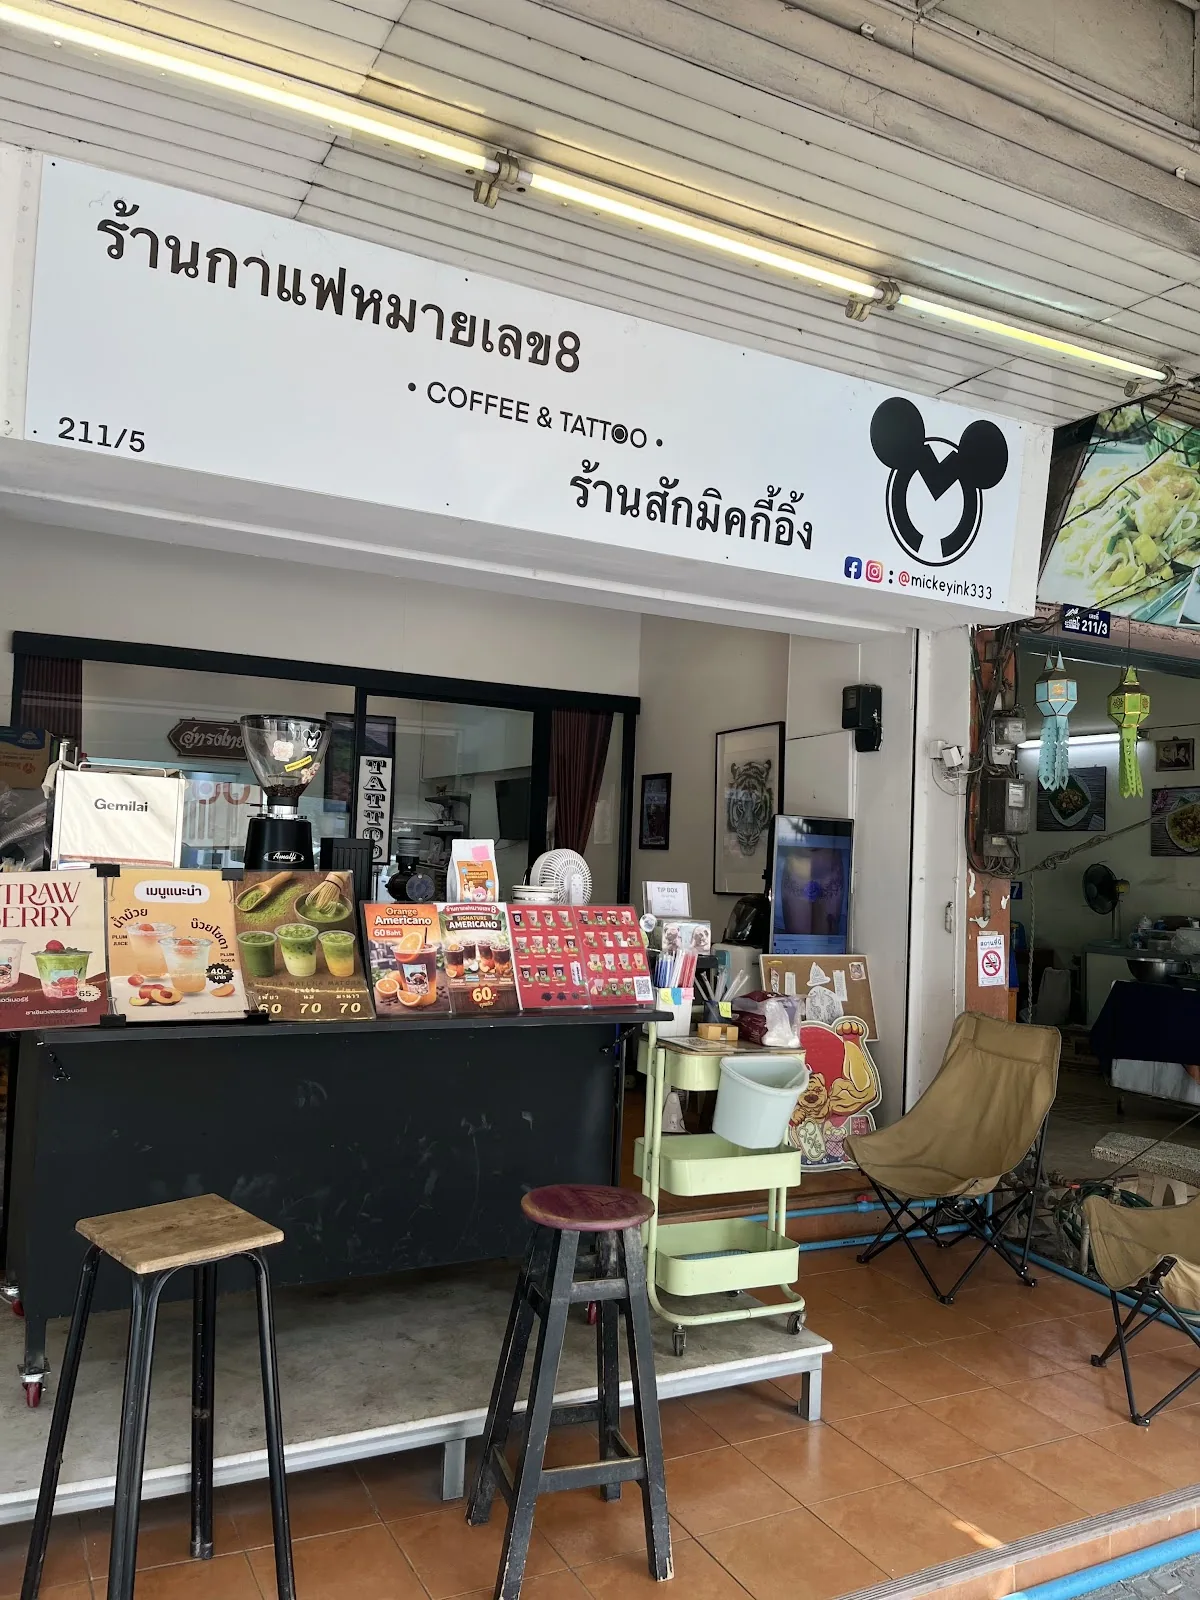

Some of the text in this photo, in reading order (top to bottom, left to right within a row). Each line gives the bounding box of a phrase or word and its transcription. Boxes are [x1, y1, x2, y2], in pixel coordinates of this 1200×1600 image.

[97, 199, 581, 373] ร้านกาแฟหมายเลข8
[427, 381, 648, 448] COFFEE & TATTOO
[58, 416, 146, 452] 211/5
[569, 459, 813, 550] ร้านสักมิคกี้อิ้ง
[898, 571, 992, 600] @mickeyink333
[1081, 619, 1108, 635] 211/3
[94, 798, 148, 812] Gemilai
[273, 852, 297, 862] Amalfi
[0, 881, 81, 906] TRAW
[146, 884, 202, 899] เมนูแนะนำ
[0, 905, 79, 928] ERRY
[111, 908, 148, 928] น้ำบ๊วย
[386, 907, 417, 916] Orange
[491, 906, 497, 914] 8
[374, 915, 432, 925] Americano
[449, 920, 498, 929] AMERICANO
[472, 986, 497, 1002] 60.-
[300, 1003, 322, 1014] 70
[340, 1002, 361, 1014] 70
